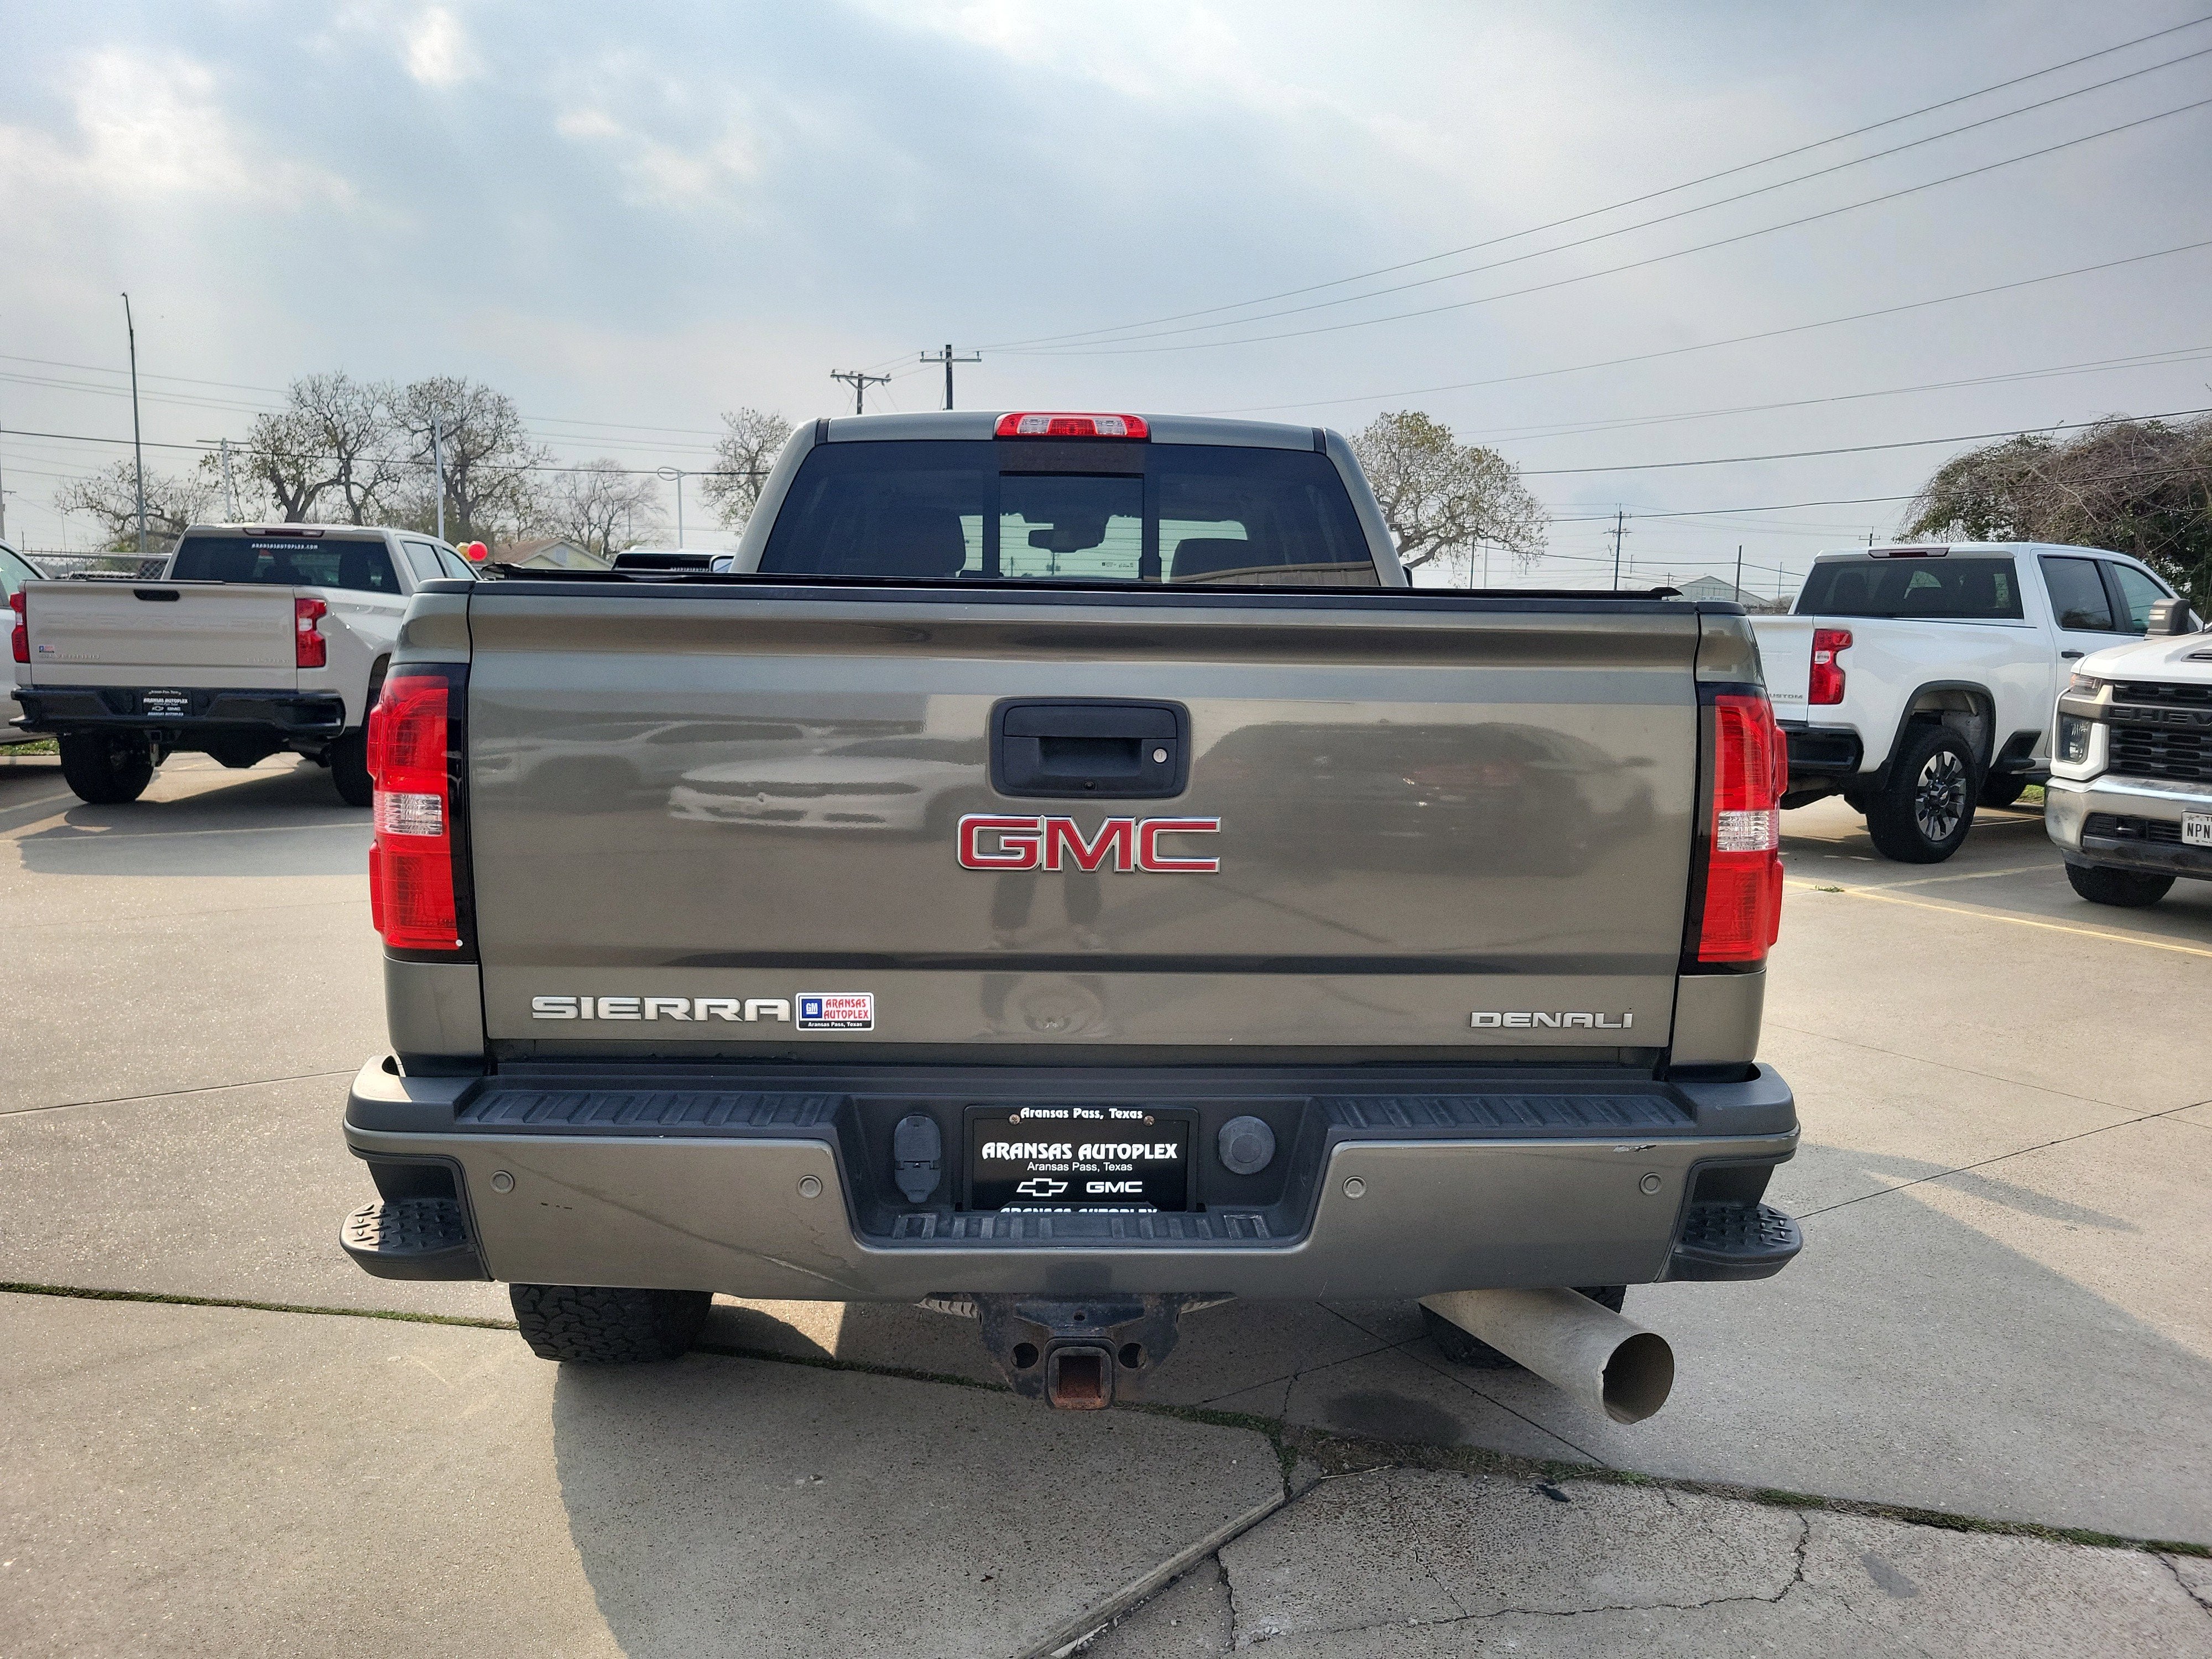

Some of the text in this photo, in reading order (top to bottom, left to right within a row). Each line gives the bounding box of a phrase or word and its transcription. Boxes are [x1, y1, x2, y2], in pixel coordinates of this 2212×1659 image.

[2187, 822, 2210, 838] NPN
[956, 813, 1222, 873] GMC
[531, 996, 791, 1022] SIERRA
[806, 1003, 818, 1013] GM
[826, 999, 866, 1009] ARANSAS
[823, 1010, 869, 1019] AUTOPLEX
[1470, 1012, 1634, 1029] DENALI
[1020, 1107, 1143, 1119] Aransas Pass, Texas
[982, 1142, 1178, 1161] ARANSAS AUTOPLEX
[1027, 1161, 1133, 1172] Aransas Pass, Texas
[1086, 1181, 1142, 1193] GMC
